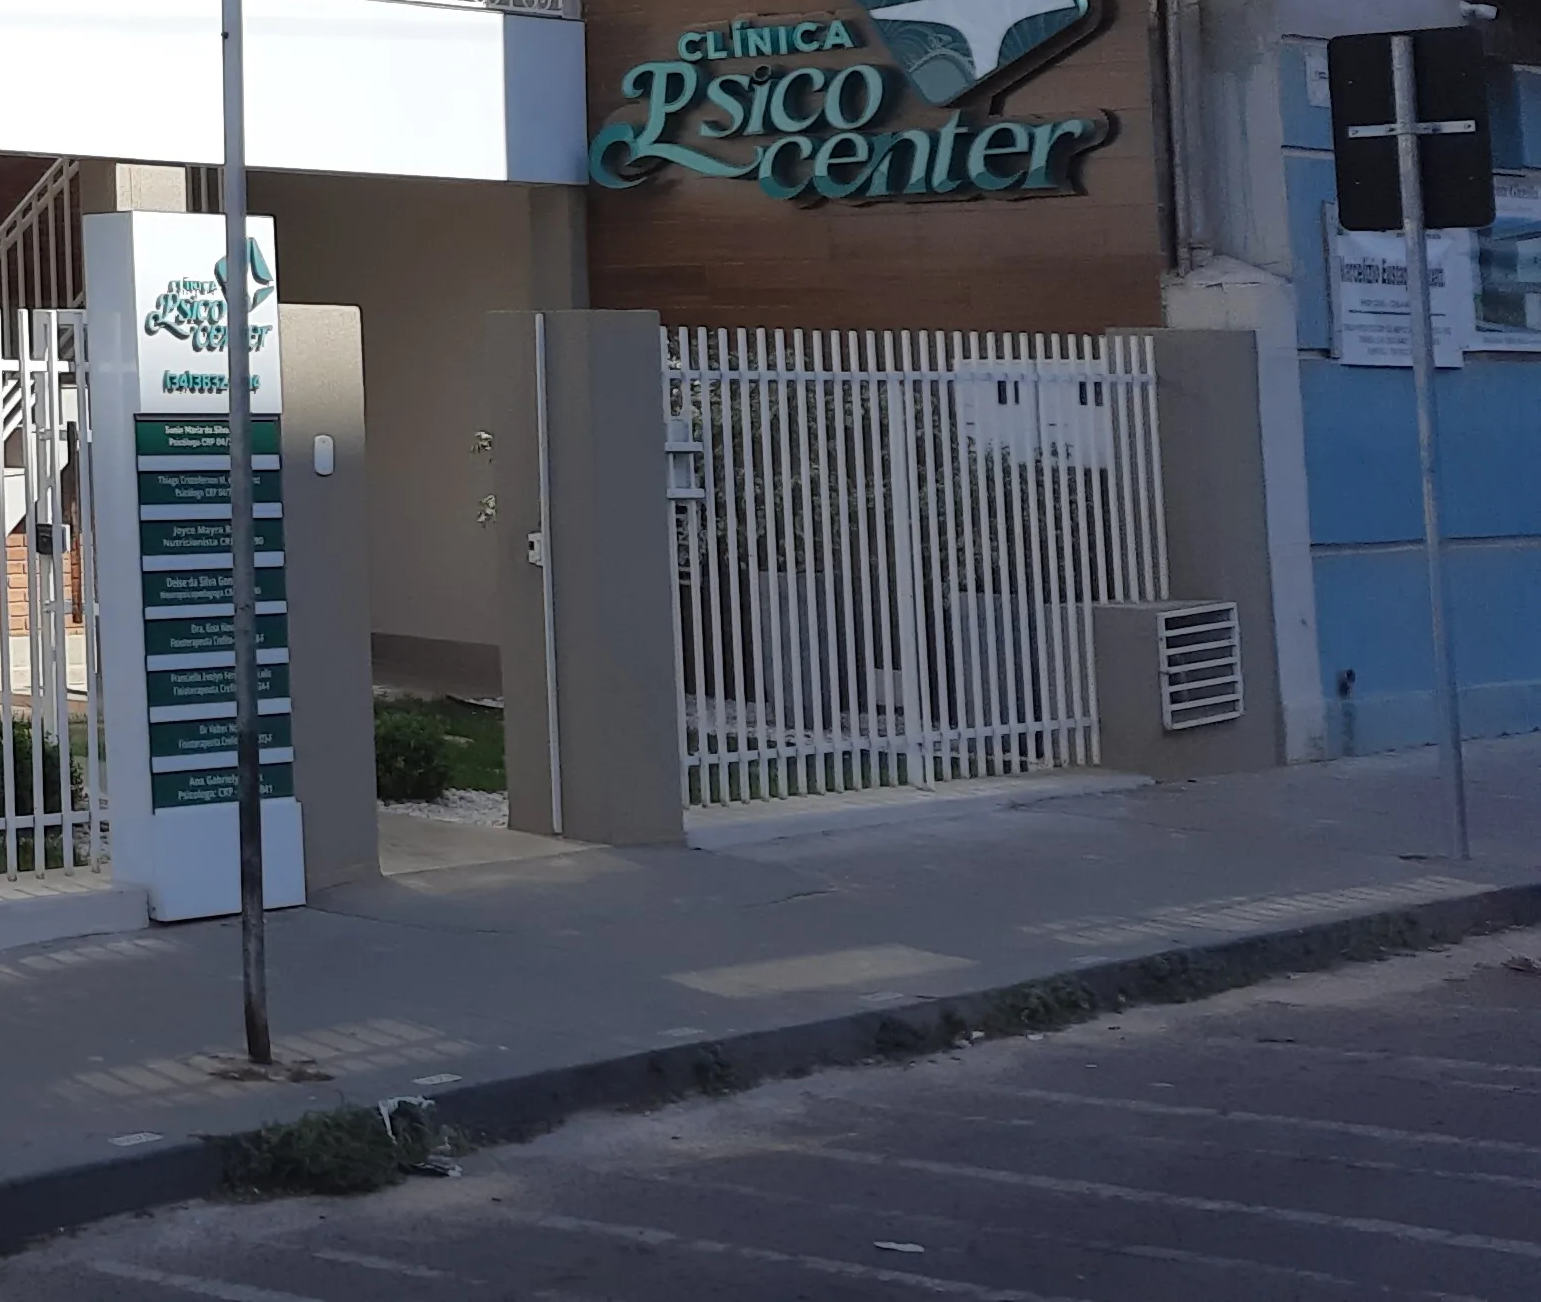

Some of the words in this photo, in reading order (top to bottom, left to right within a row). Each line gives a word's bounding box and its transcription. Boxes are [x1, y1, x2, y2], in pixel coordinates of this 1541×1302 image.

[678, 18, 855, 62] CLÍNICA
[589, 60, 884, 190] Psico
[758, 109, 1096, 200] center
[162, 537, 219, 548] Nutricionista
